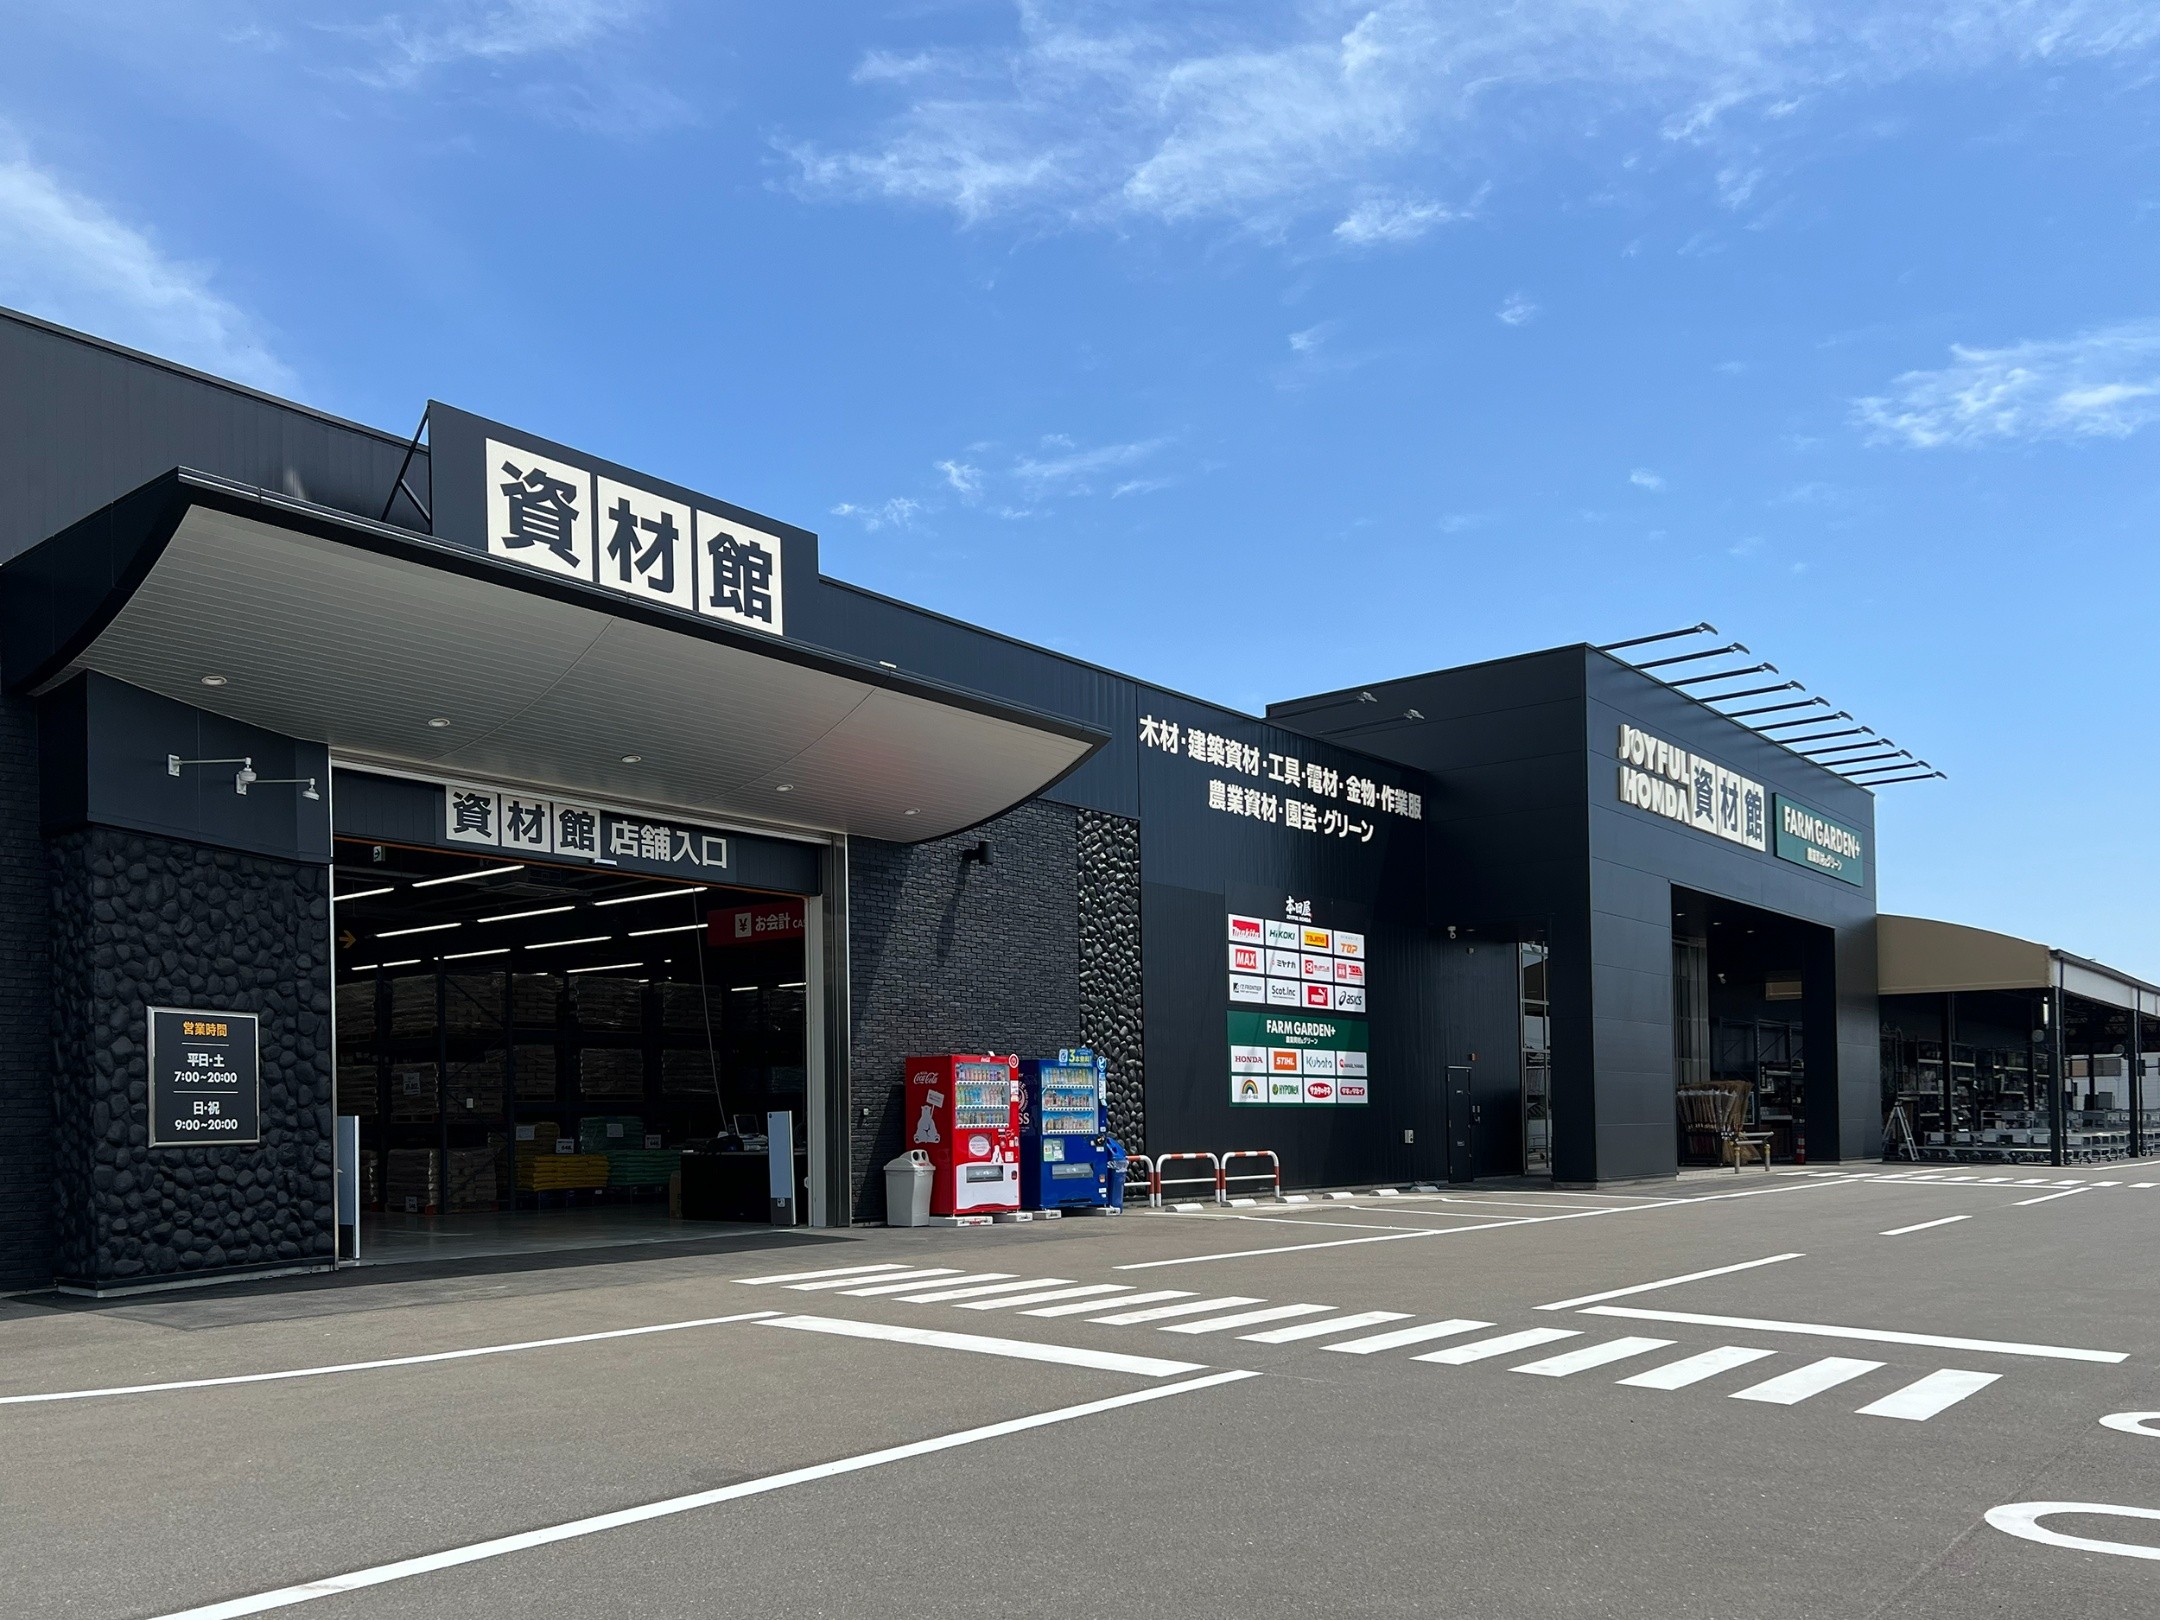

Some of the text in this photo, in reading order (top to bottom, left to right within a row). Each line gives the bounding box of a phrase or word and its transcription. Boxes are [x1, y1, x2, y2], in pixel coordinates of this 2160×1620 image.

[500, 461, 773, 624] 資材館
[1619, 724, 1690, 785] JOYFUL
[1619, 766, 1690, 825] HONDA
[1694, 764, 1763, 844] 資材館
[452, 791, 727, 869] 資材館 店舗入口
[1784, 805, 1814, 843] FARM
[756, 912, 791, 931] お会計
[1236, 949, 1256, 967] MAX
[1340, 943, 1358, 954] TOP
[183, 1021, 228, 1037] 営業時間
[1266, 1020, 1336, 1037] FARM GARDEN+
[1276, 1057, 1295, 1065] STIHL
[1306, 1056, 1333, 1068] Kubota
